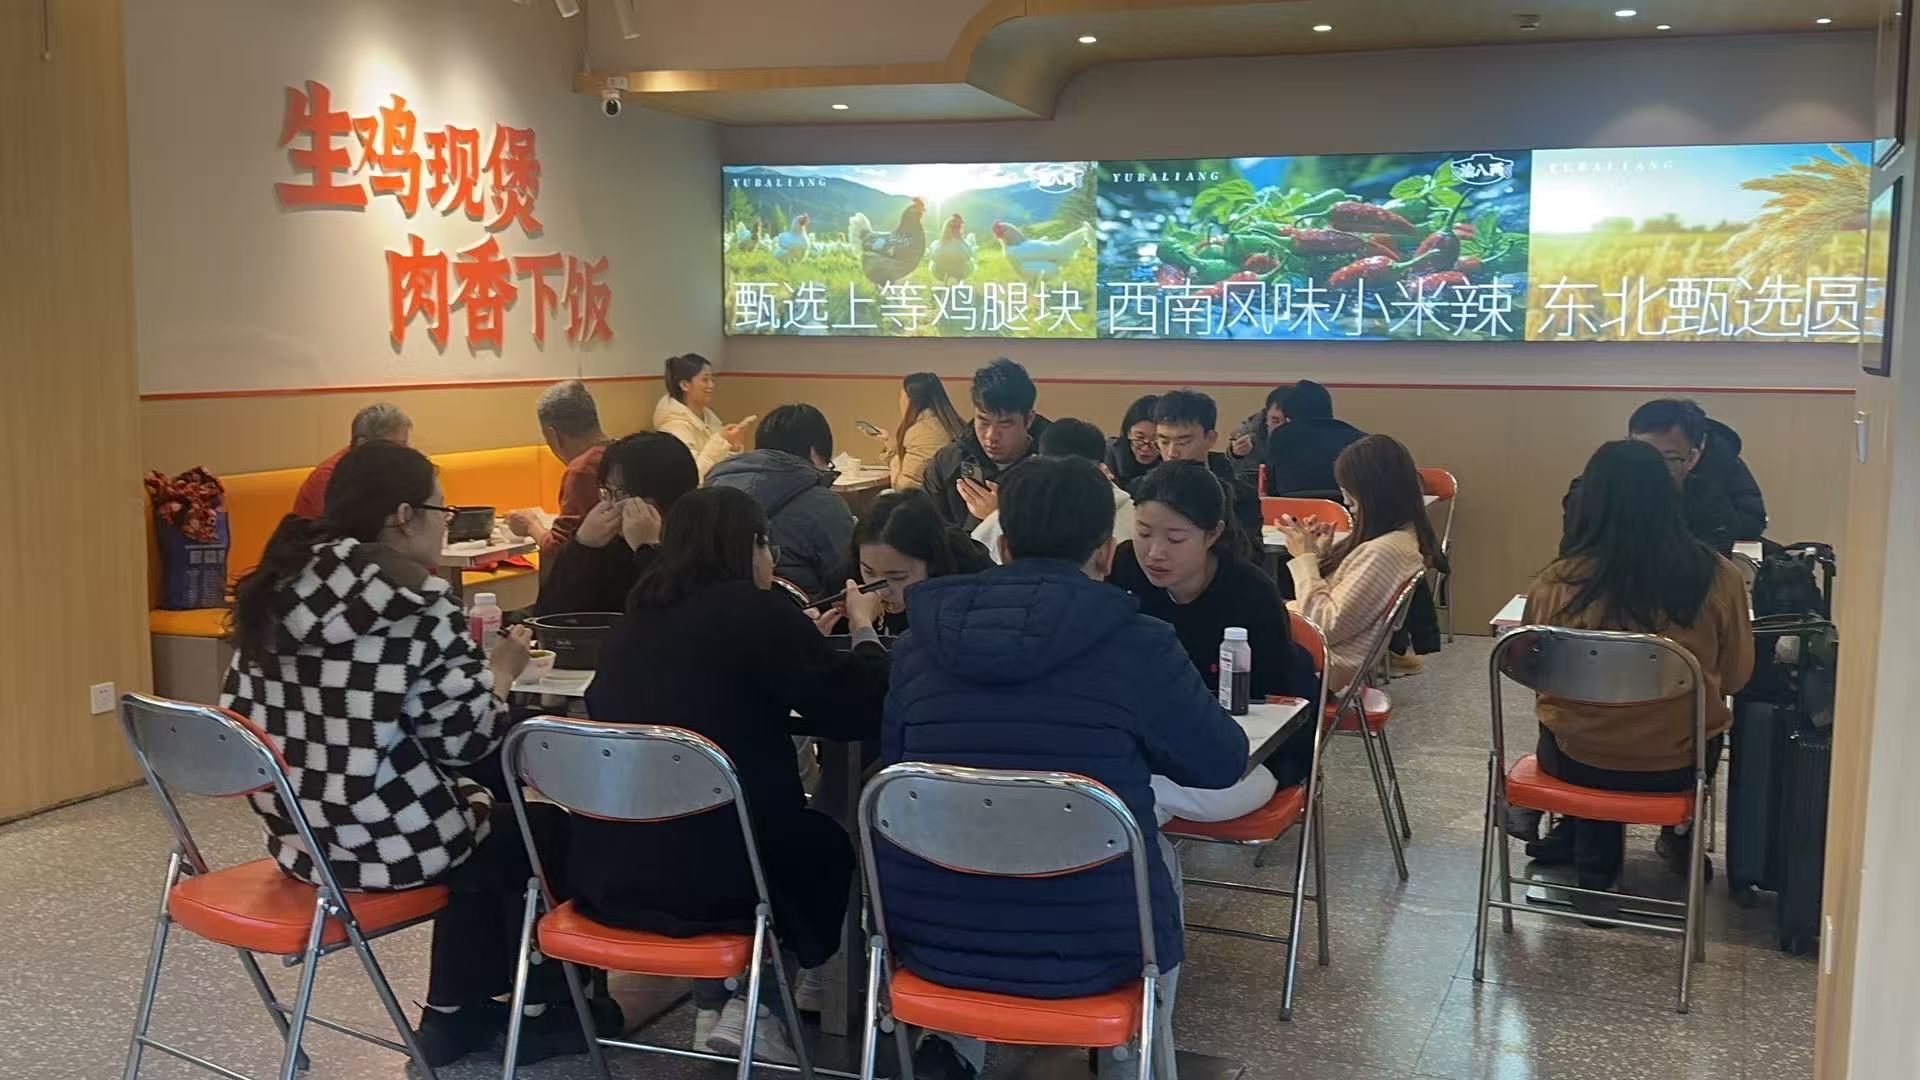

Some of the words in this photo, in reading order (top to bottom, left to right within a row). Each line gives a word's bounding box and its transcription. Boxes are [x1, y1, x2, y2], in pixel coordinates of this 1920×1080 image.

[275, 80, 543, 234] 生鸡现煲
[733, 176, 828, 188] YUBALIANG
[1112, 170, 1222, 183] YUBALIANG
[386, 234, 614, 349] 肉香下饭
[734, 280, 1084, 334] 甄选上等鸡腿块
[1107, 276, 1515, 338] 西南风味小米辣
